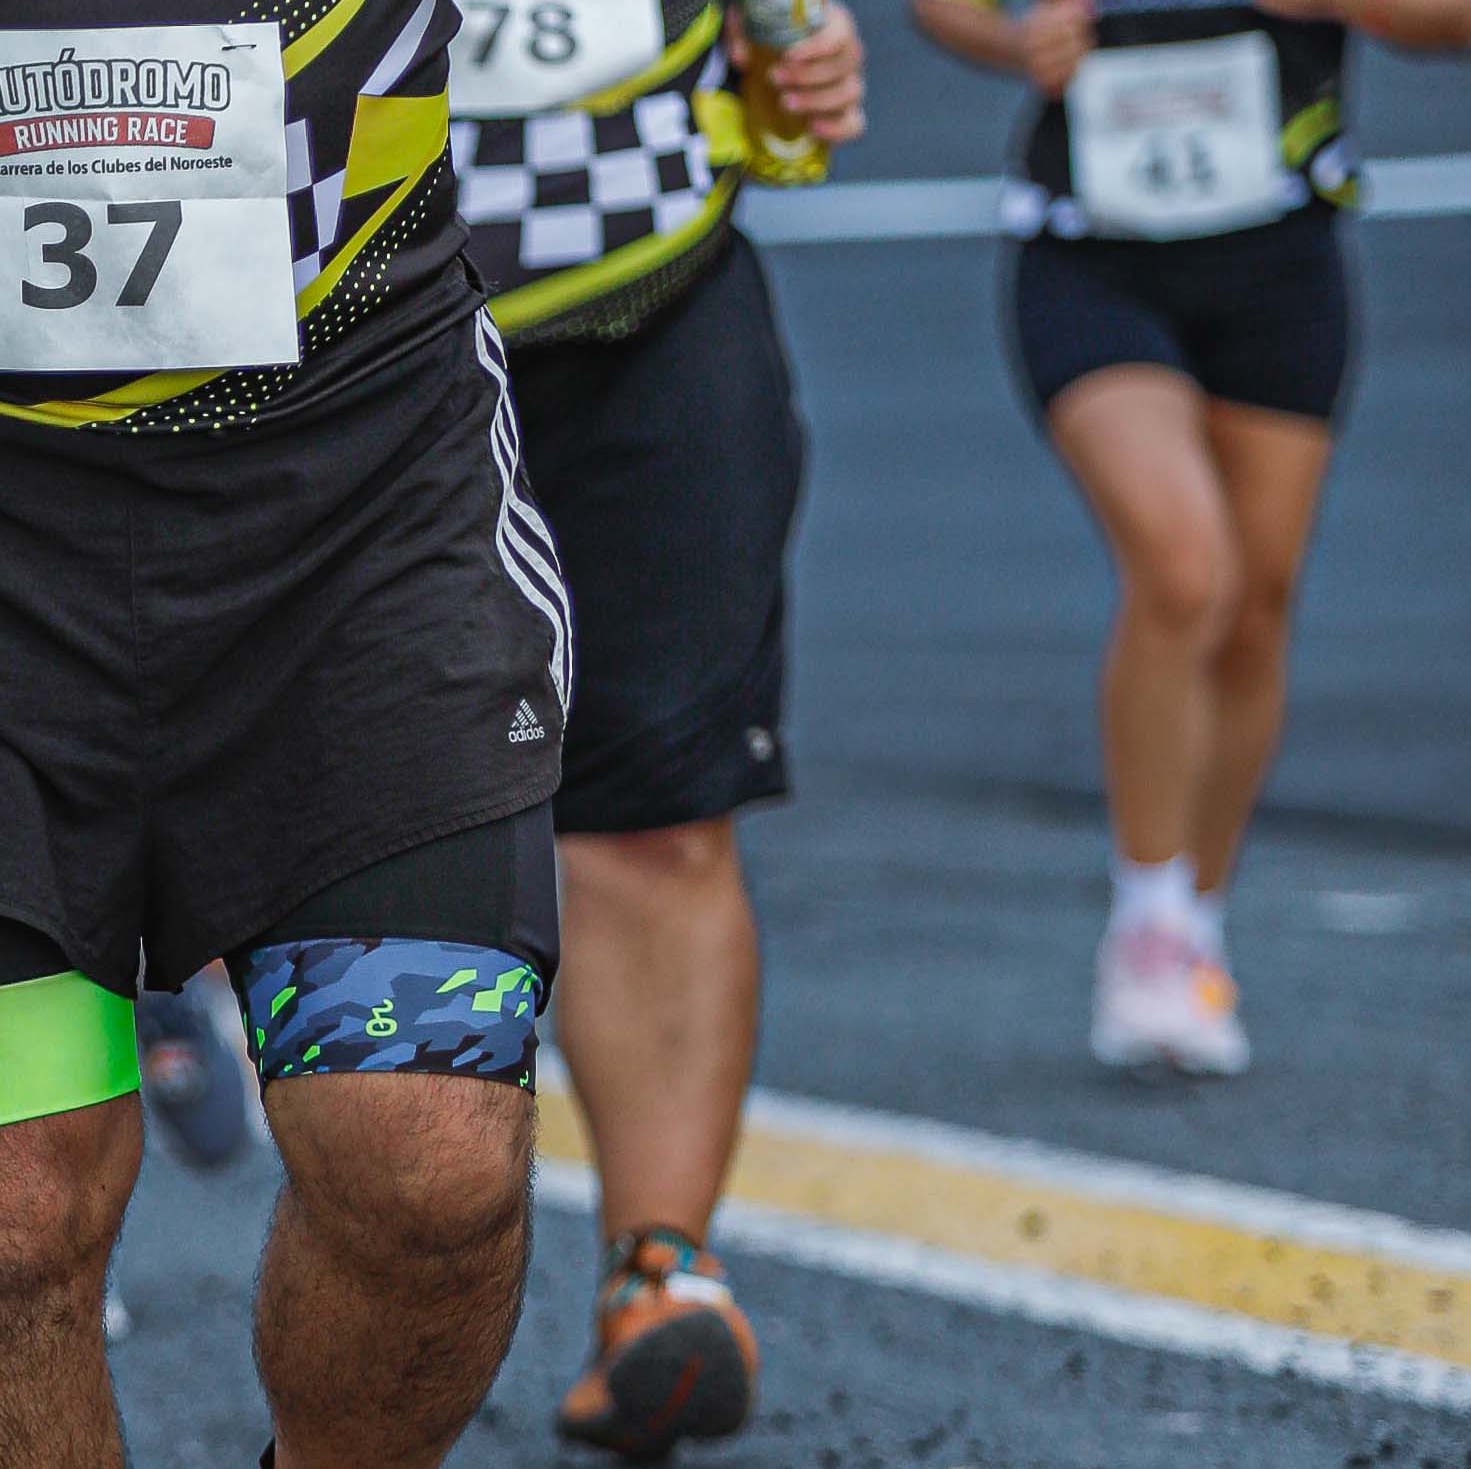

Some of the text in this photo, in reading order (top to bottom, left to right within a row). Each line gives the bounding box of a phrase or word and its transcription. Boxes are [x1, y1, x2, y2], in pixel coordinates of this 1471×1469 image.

[465, 0, 578, 67] 78
[13, 116, 188, 150] RUNNING RACE
[46, 160, 65, 175] de
[67, 160, 88, 175] los
[91, 158, 142, 174] Clubes
[144, 156, 168, 172] del
[170, 155, 233, 171] Noroeste
[21, 200, 184, 310] 37
[508, 724, 545, 743] adidas
